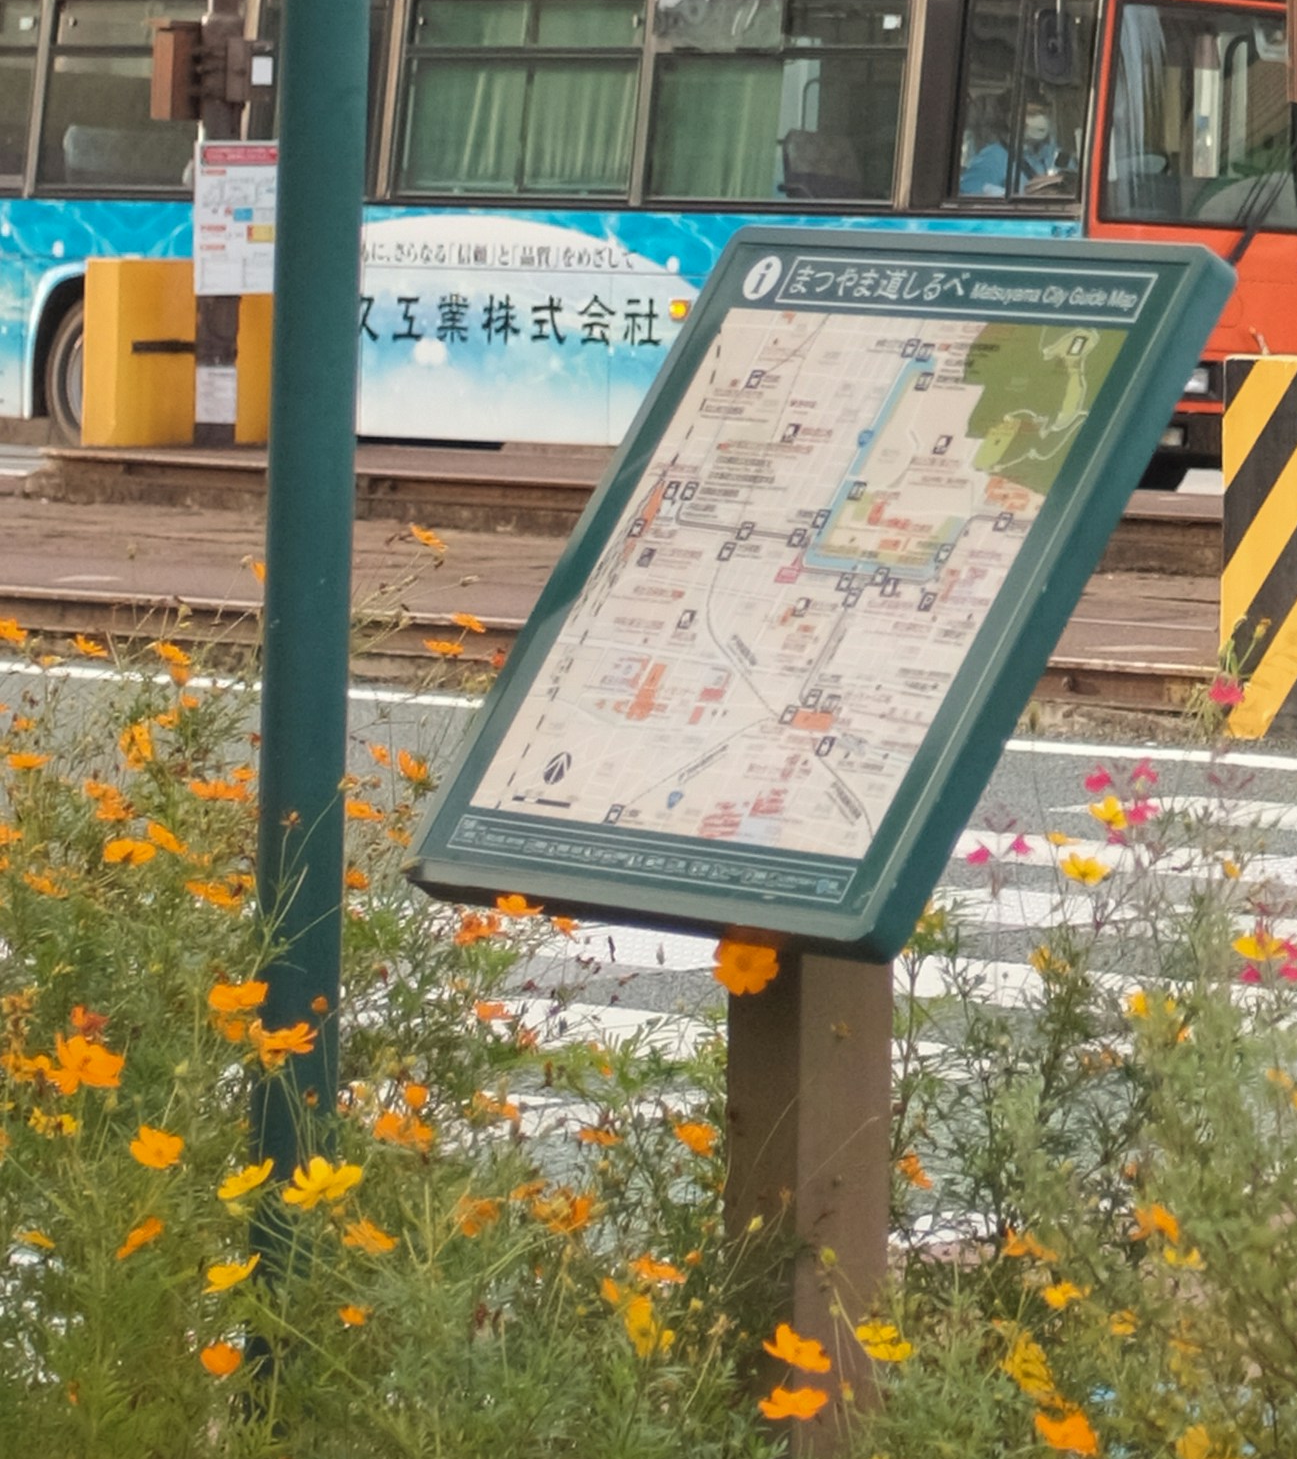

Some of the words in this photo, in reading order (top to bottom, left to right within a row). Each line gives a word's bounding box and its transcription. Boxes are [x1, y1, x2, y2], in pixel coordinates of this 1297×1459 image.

[788, 265, 971, 301] まつやま道しるべ
[970, 282, 1039, 305] Matsuyama
[1041, 285, 1067, 308] City
[1068, 287, 1107, 308] Guide
[1107, 290, 1138, 313] Map
